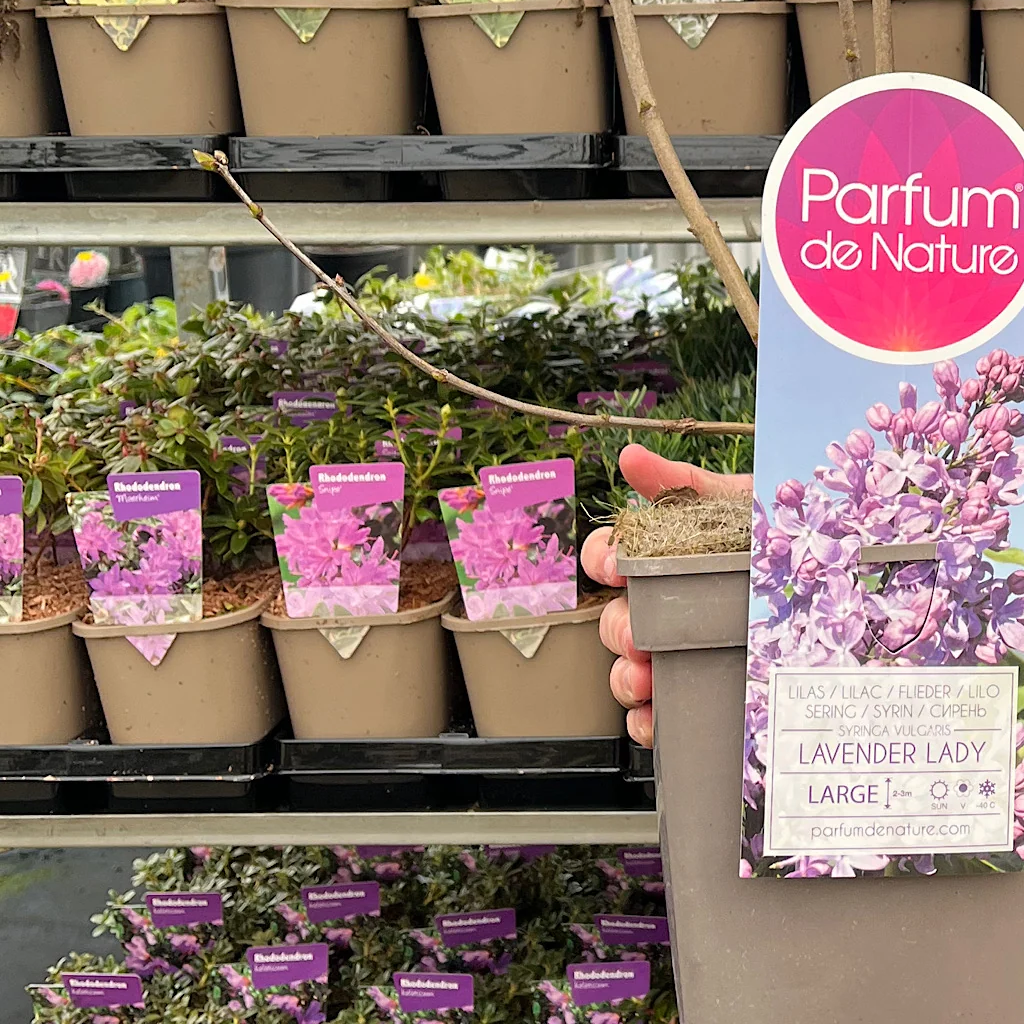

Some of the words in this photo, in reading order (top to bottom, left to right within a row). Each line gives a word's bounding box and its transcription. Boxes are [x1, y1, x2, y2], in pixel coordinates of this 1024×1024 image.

[801, 230, 863, 270] de
[872, 231, 1018, 275] Nature
[318, 472, 386, 483] Rhododendron
[488, 470, 556, 484] Rhododendron
[114, 481, 181, 492] Rhododendron
[788, 684, 826, 699] LILAS
[841, 684, 882, 699] LILAC
[898, 684, 952, 699] FLIEDER
[968, 683, 1000, 698] LILO
[804, 704, 857, 719] SERING
[873, 704, 913, 718] SYRIN
[838, 724, 889, 737] SYRINGA
[894, 724, 951, 736] VULGARIS
[799, 742, 916, 764] LAVENDER
[927, 741, 986, 764] LADY
[808, 784, 879, 804] LARGE
[892, 790, 913, 798] 2-3m
[811, 822, 970, 840] parfumdenature.com
